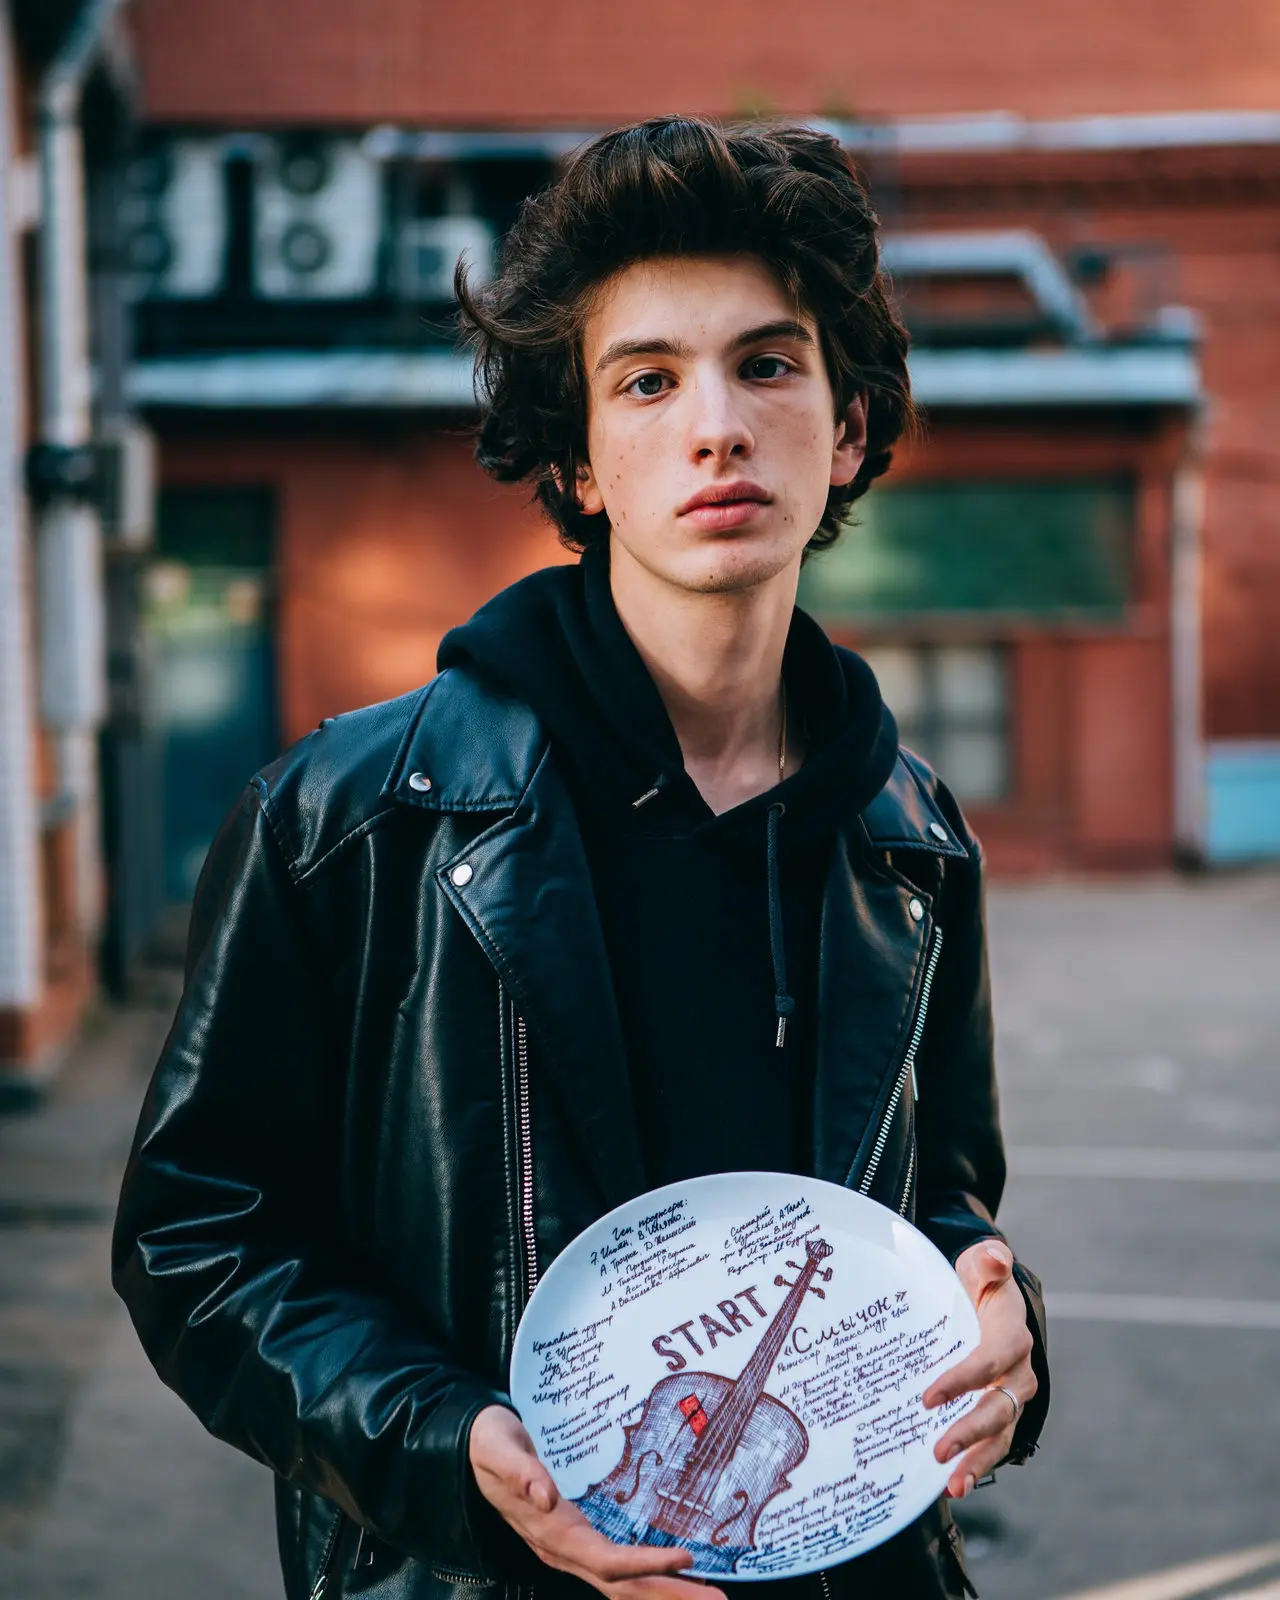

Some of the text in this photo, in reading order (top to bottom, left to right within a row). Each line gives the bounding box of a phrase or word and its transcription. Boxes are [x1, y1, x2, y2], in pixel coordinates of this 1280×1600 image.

[730, 1205, 770, 1240] Сценарий
[652, 1285, 767, 1371] START
[833, 1317, 887, 1356] Александр
